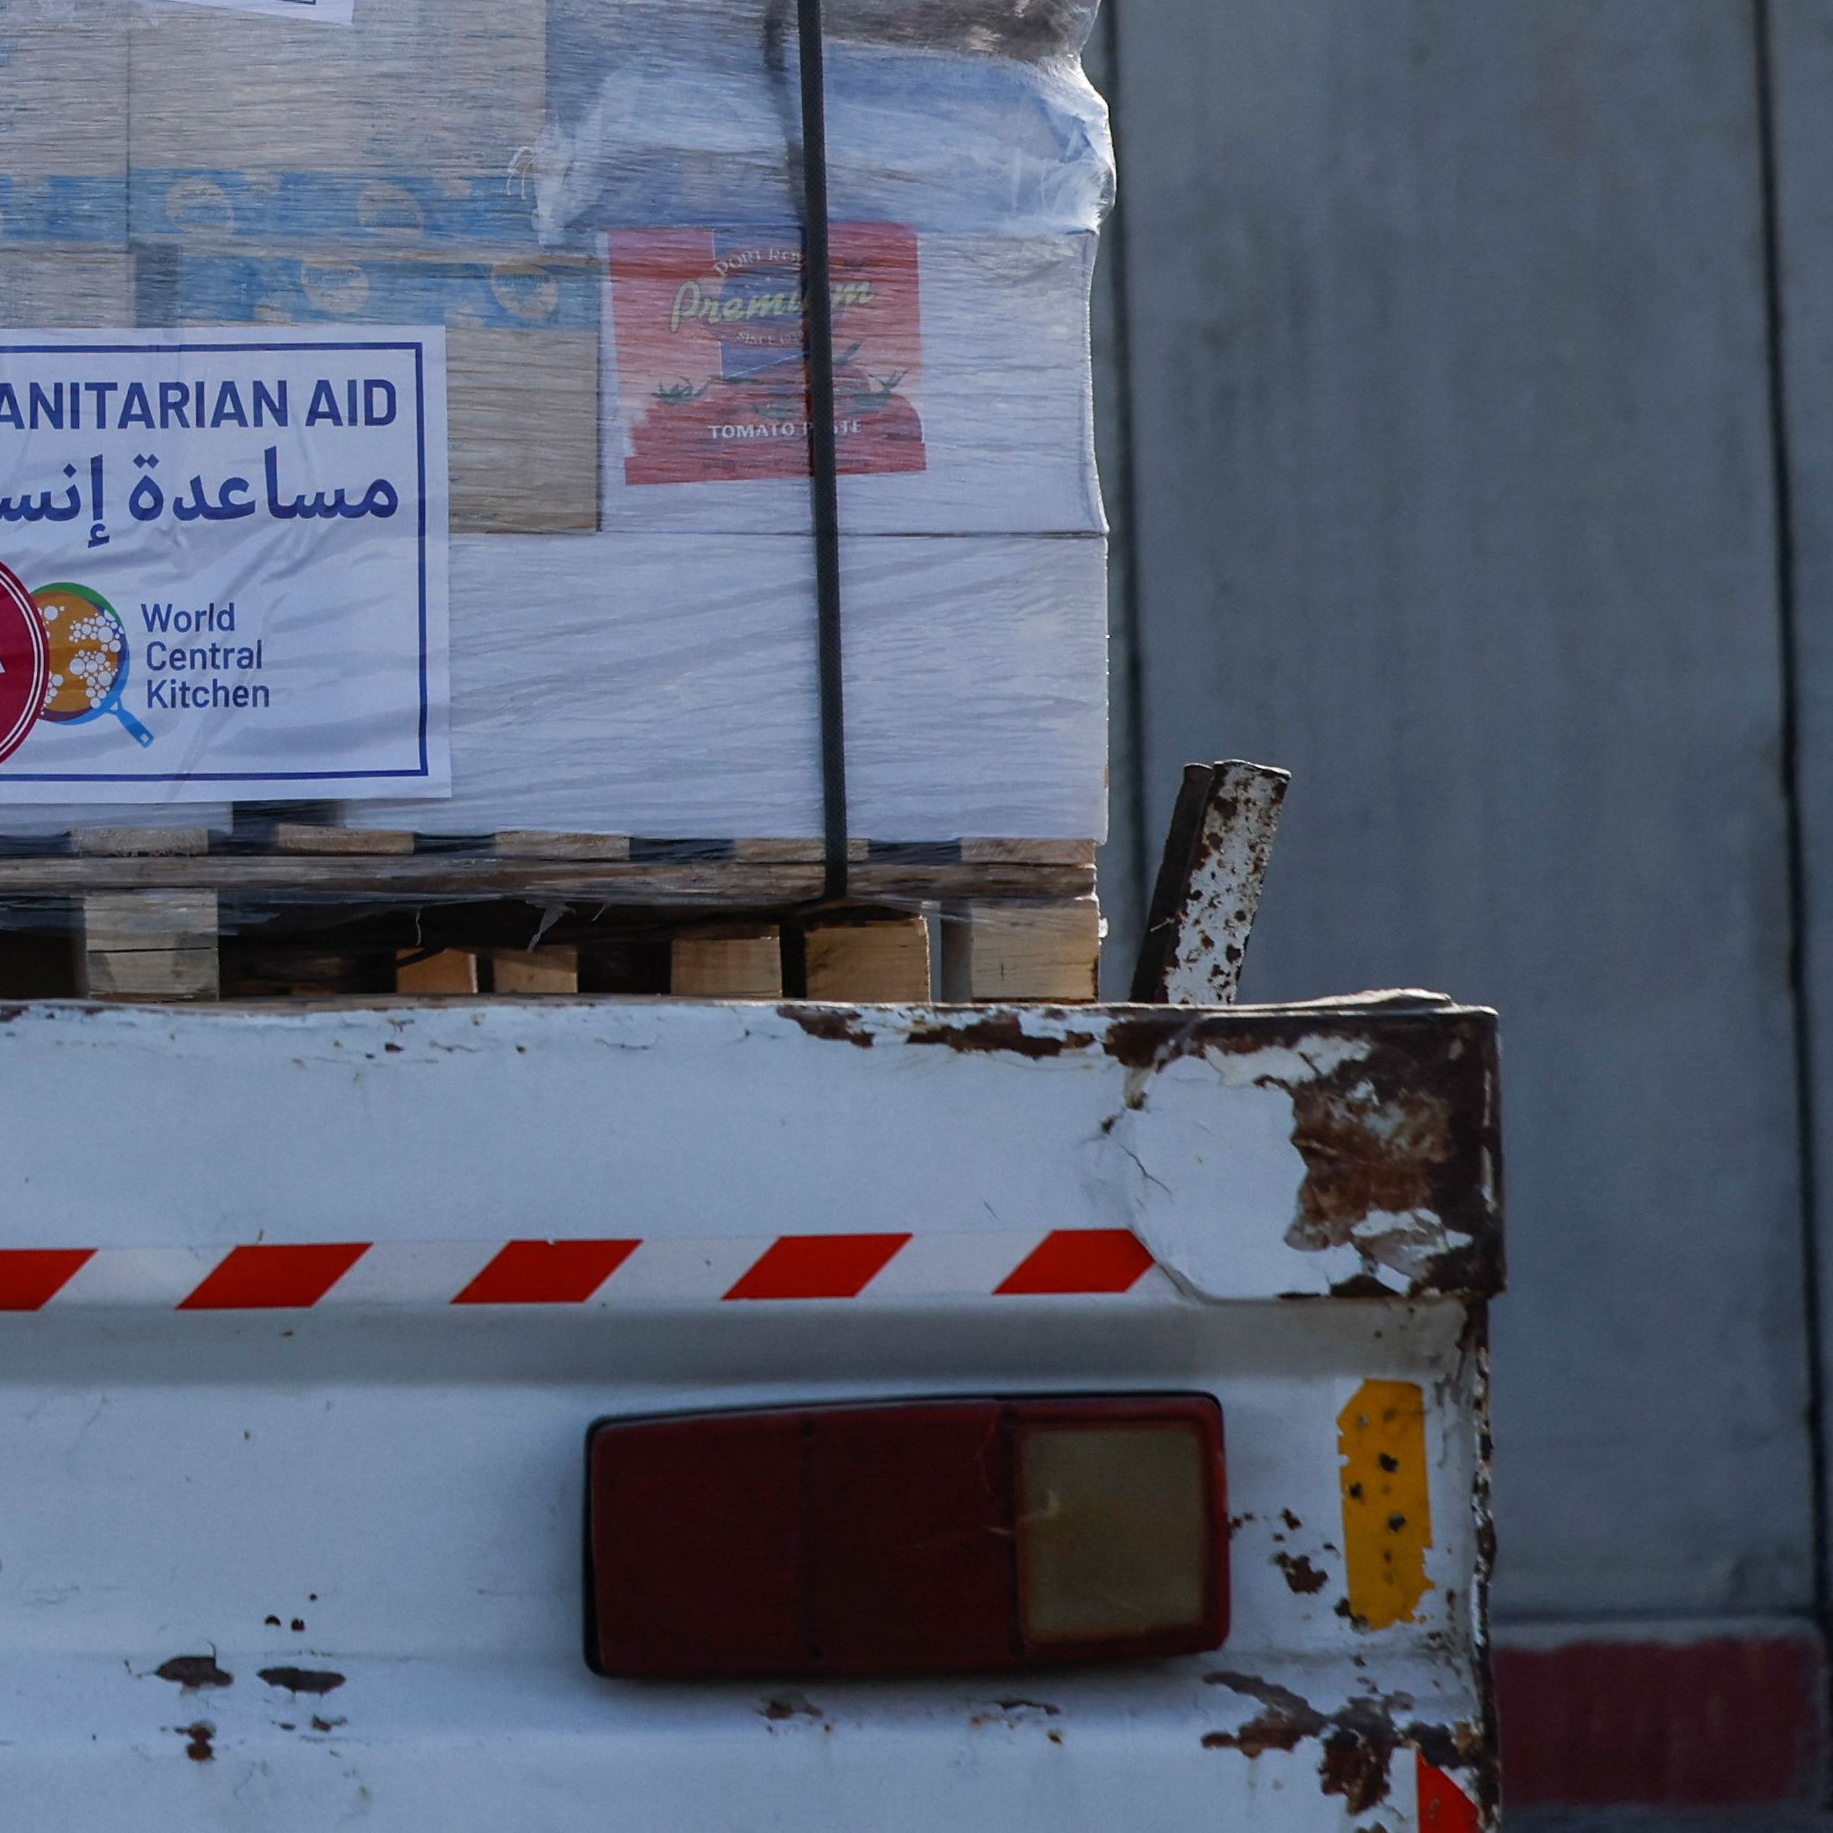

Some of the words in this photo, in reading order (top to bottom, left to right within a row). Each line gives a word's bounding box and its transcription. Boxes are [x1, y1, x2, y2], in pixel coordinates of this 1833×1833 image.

[669, 280, 876, 334] Premim
[305, 379, 397, 427] AID
[708, 422, 796, 440] TOMATO
[802, 419, 863, 439] PSTE
[128, 445, 399, 522] مساعدة
[140, 602, 236, 633] World
[146, 639, 263, 672] Central
[147, 678, 271, 710] Kitchen
